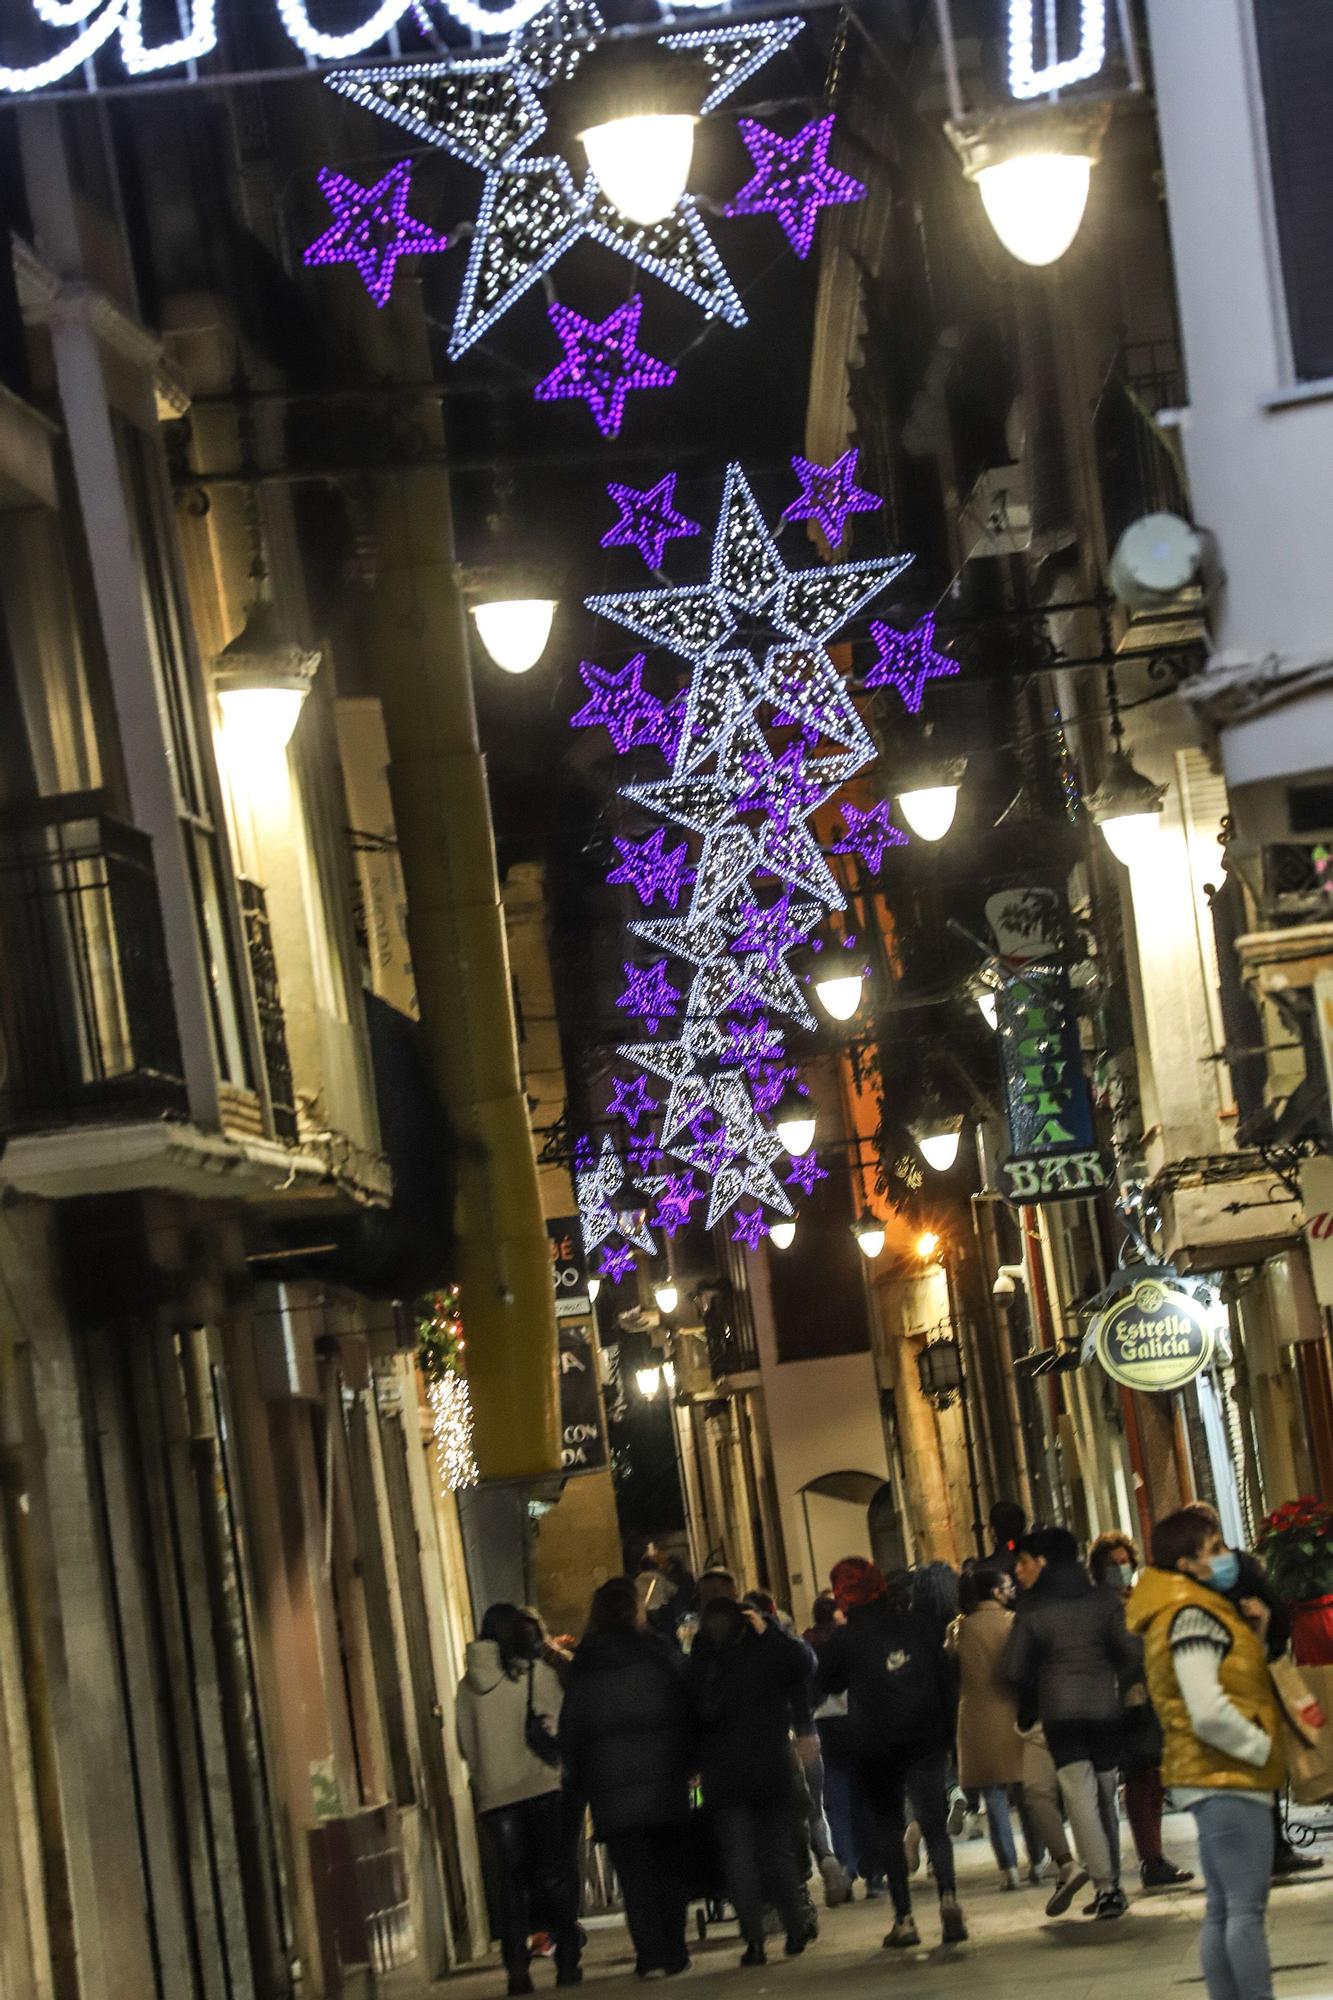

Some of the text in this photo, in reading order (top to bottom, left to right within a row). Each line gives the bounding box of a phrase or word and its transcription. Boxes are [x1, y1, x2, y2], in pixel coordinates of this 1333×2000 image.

[1003, 1152, 1107, 1198] BAR
[1115, 1314, 1193, 1342] Estrella
[1120, 1334, 1191, 1361] Galicia
